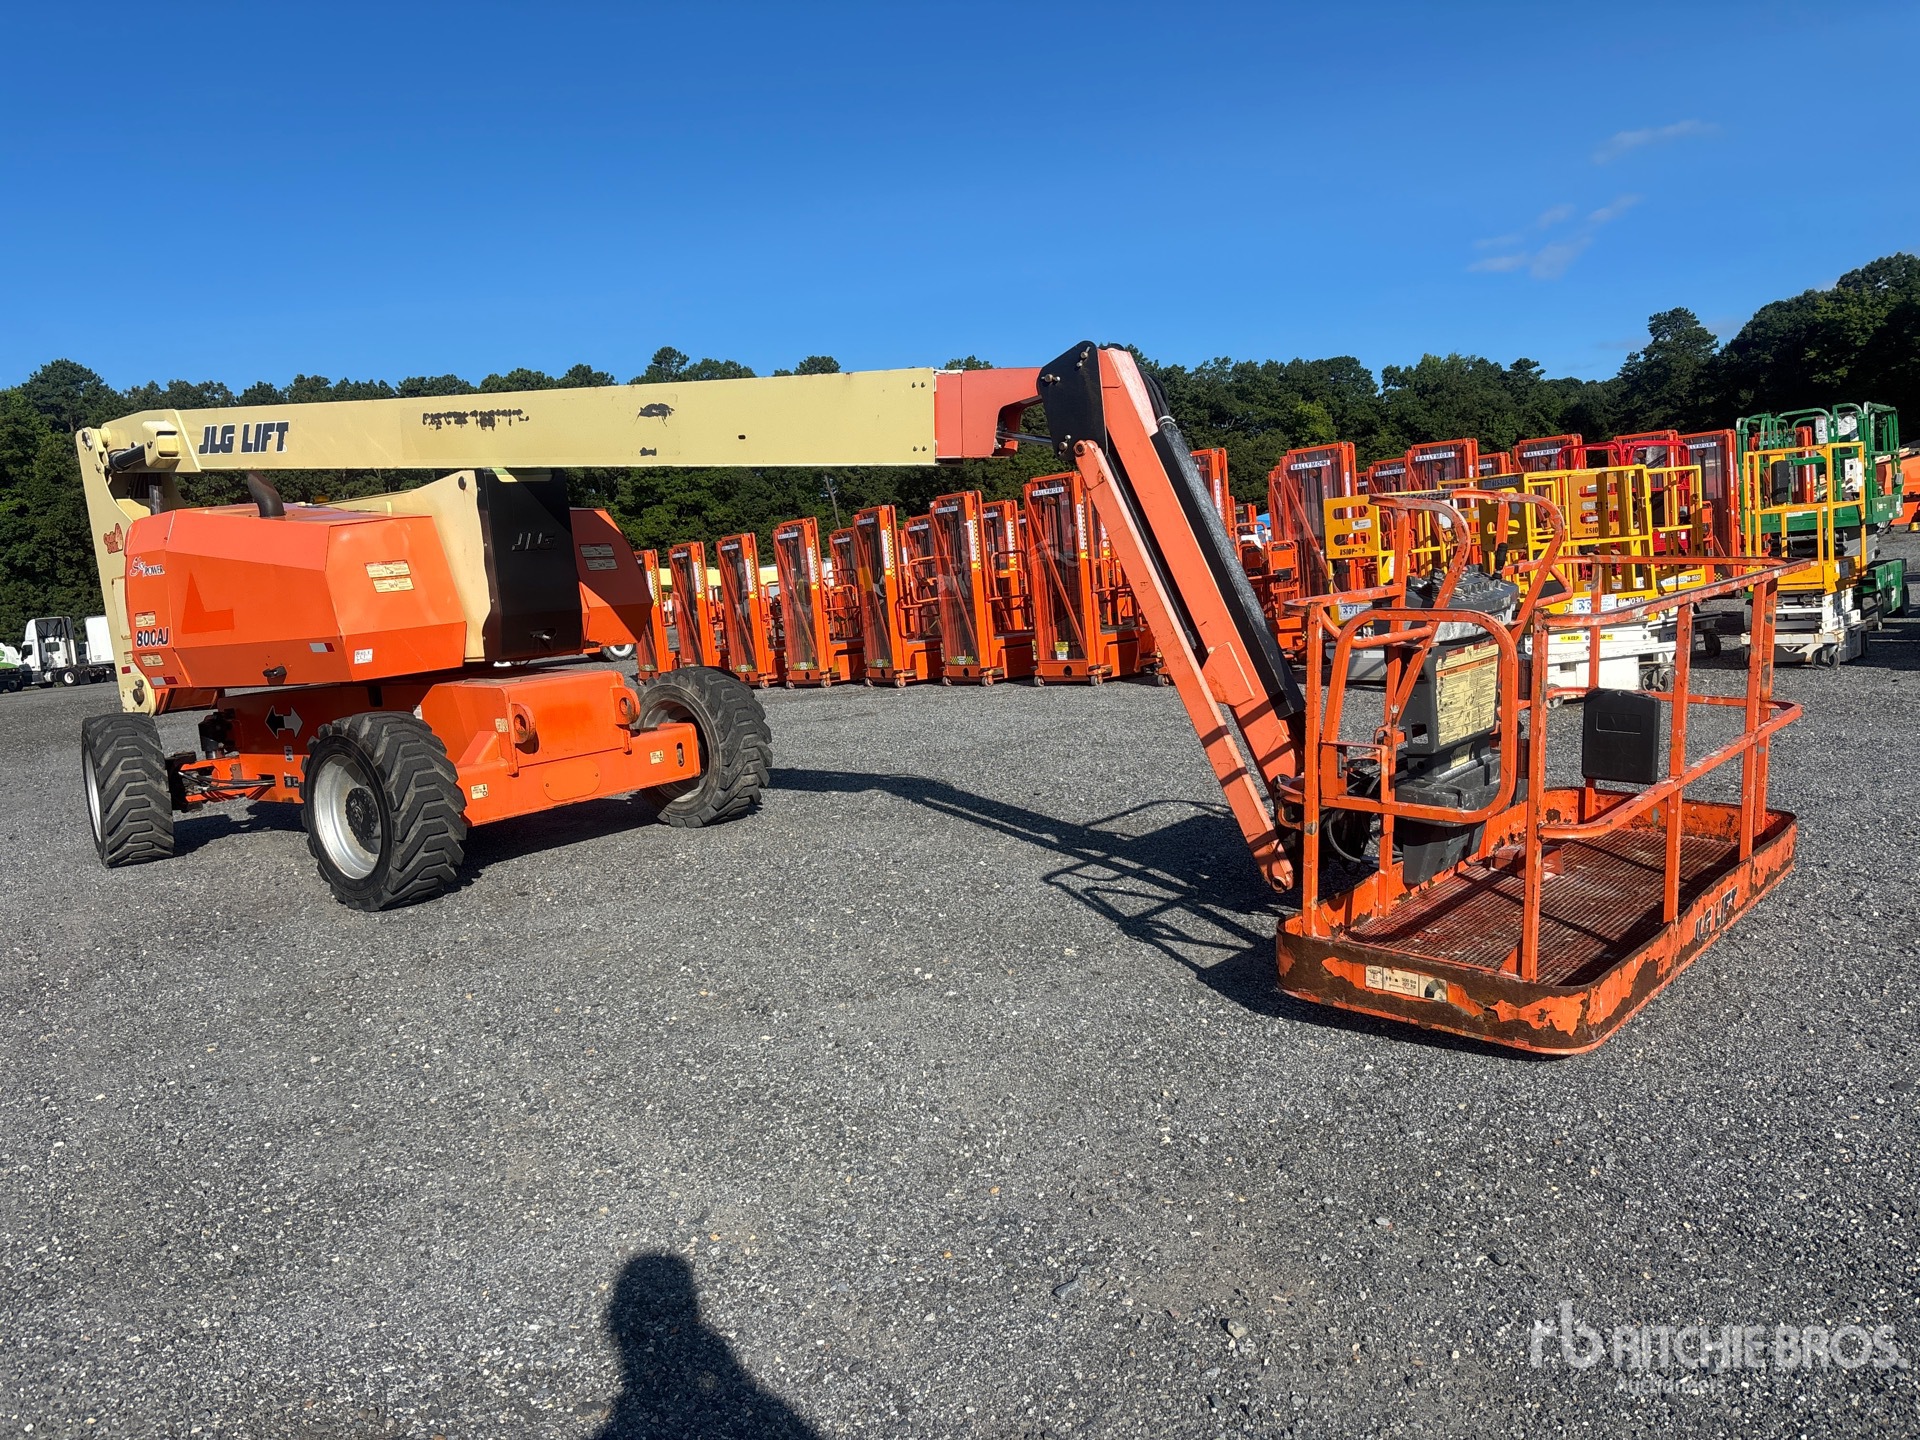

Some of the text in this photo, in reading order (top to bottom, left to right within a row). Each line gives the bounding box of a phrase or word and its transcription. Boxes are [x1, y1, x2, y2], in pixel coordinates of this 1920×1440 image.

[199, 421, 289, 454] JLG LIFT
[1416, 452, 1453, 461] BALLYMORE
[1292, 461, 1329, 470] BALLYMORE
[1033, 487, 1063, 496] BALLYMORE
[137, 628, 169, 648] 800AJ
